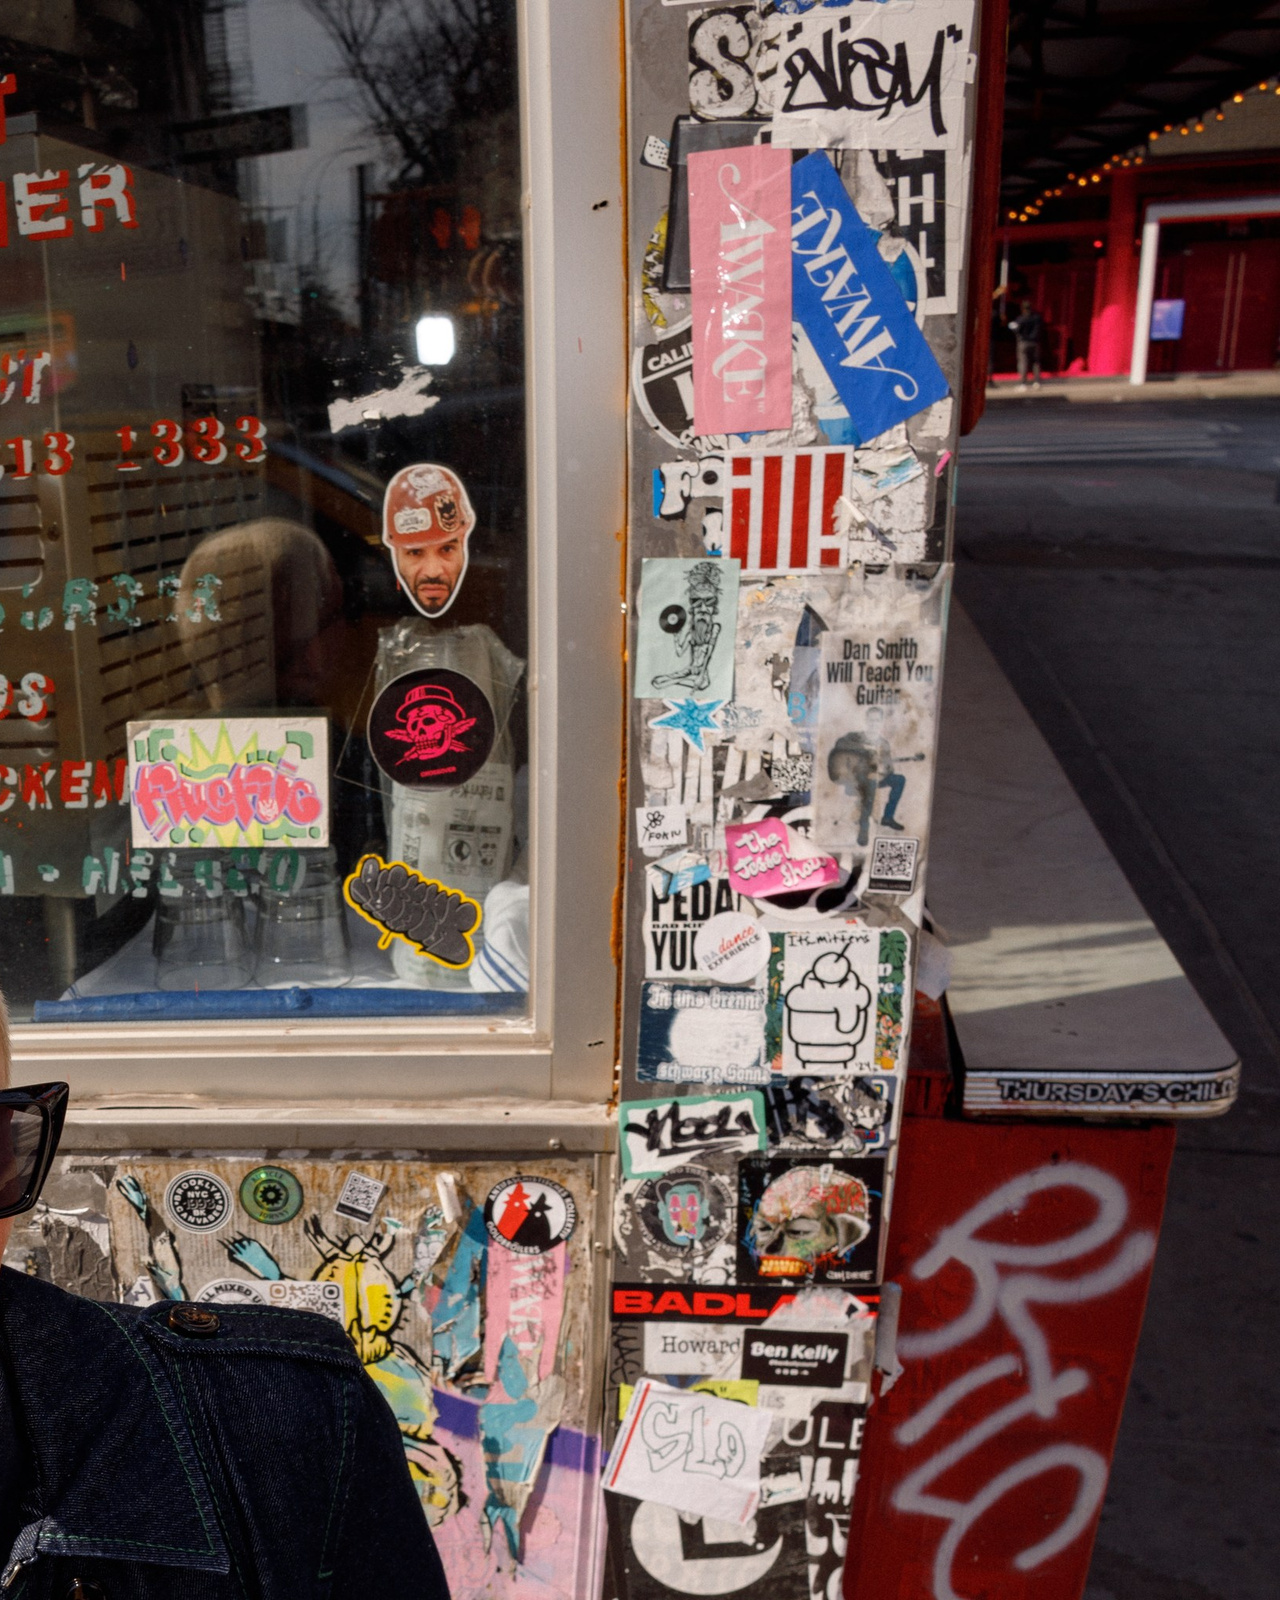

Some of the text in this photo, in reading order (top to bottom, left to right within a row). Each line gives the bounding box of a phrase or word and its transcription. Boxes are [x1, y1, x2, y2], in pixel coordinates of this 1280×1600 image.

[711, 163, 770, 404] AWAKE
[115, 415, 267, 471] 1333
[843, 637, 918, 661] Dan Smith
[826, 660, 934, 684] Will Teach You
[856, 684, 902, 706] Guitar
[707, 935, 762, 972] EXPERIENCE
[998, 1080, 1160, 1103] THURSDAY'S
[174, 1179, 223, 1202] BROOKLYN
[187, 1190, 209, 1199] NYC
[192, 1209, 207, 1217] BK
[214, 1281, 253, 1298] MIXED
[661, 1335, 741, 1354] Howard
[750, 1341, 839, 1364] Ben Kelly
